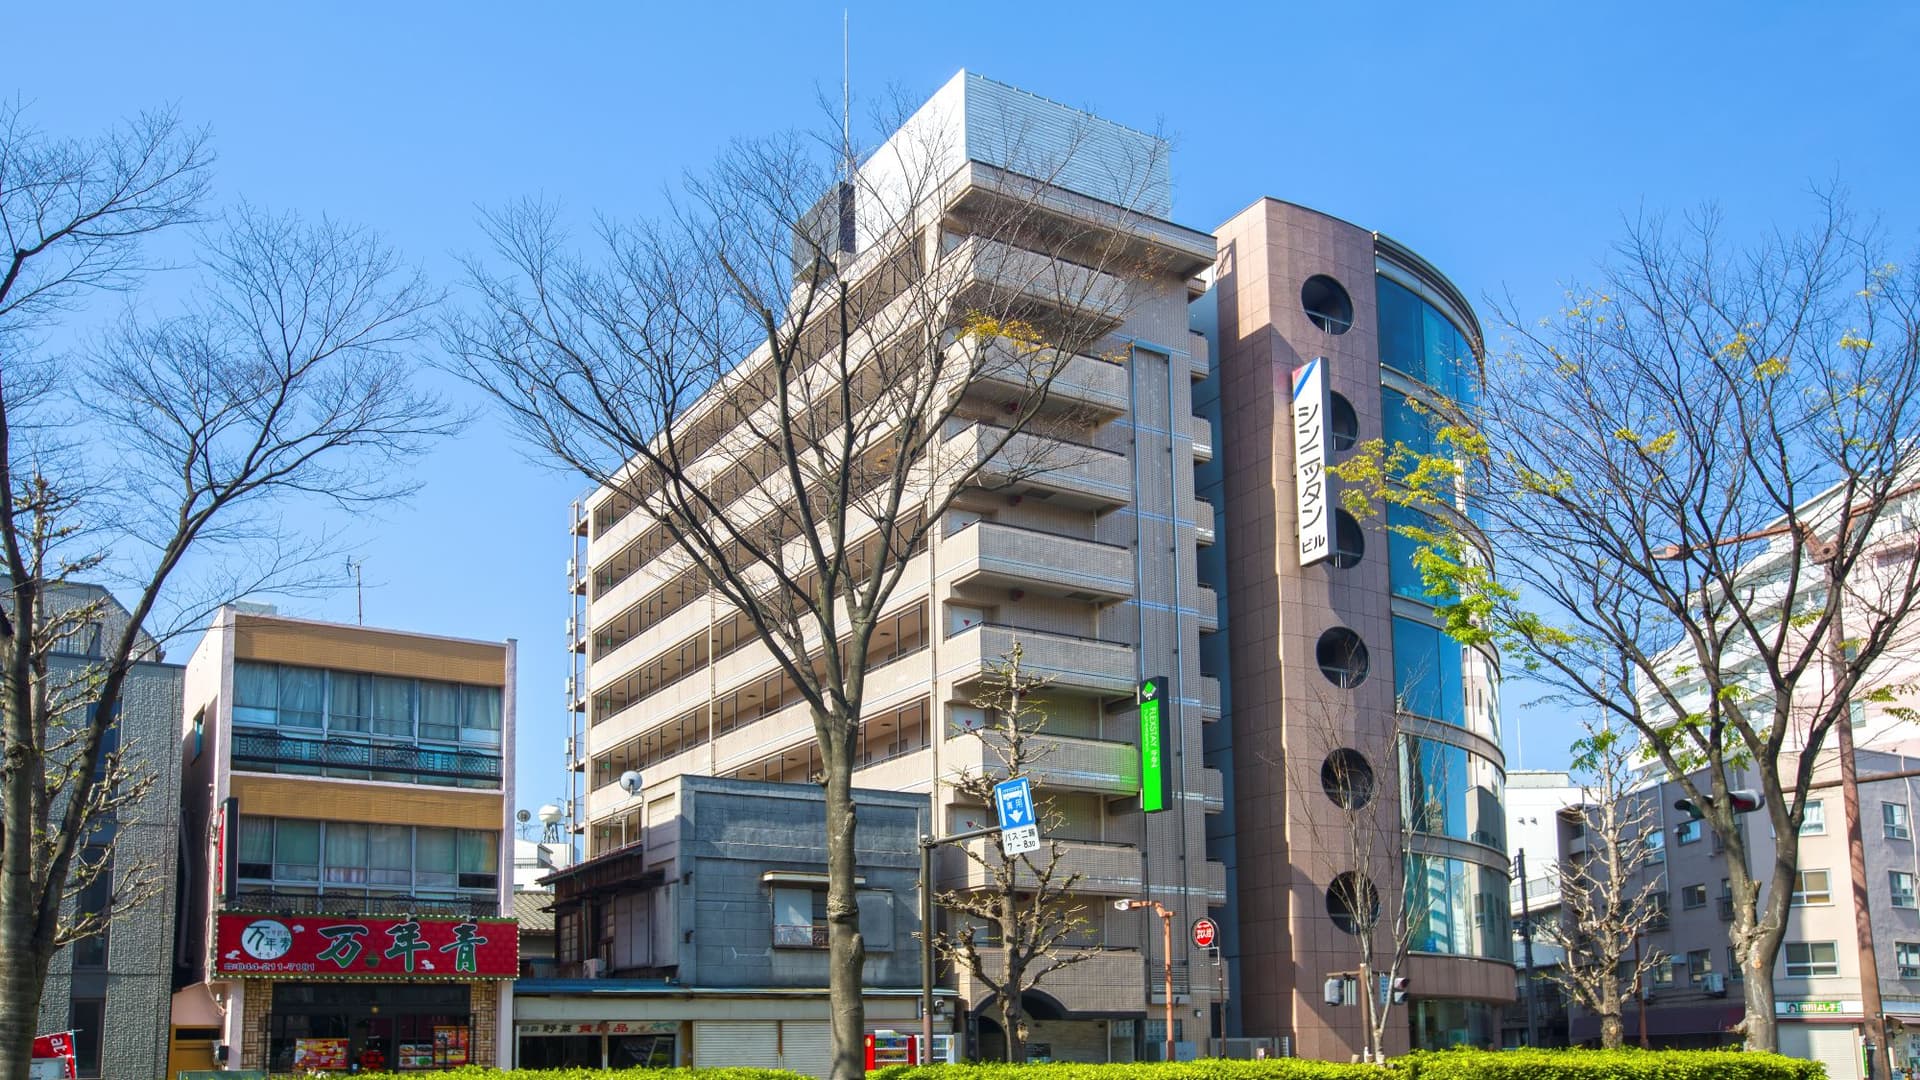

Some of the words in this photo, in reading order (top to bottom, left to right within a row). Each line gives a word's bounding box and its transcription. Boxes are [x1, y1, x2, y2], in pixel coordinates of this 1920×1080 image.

[1298, 403, 1322, 529] シンニッタン
[1302, 534, 1325, 554] ビル
[1151, 750, 1159, 768] INN
[316, 921, 488, 972] 万年青
